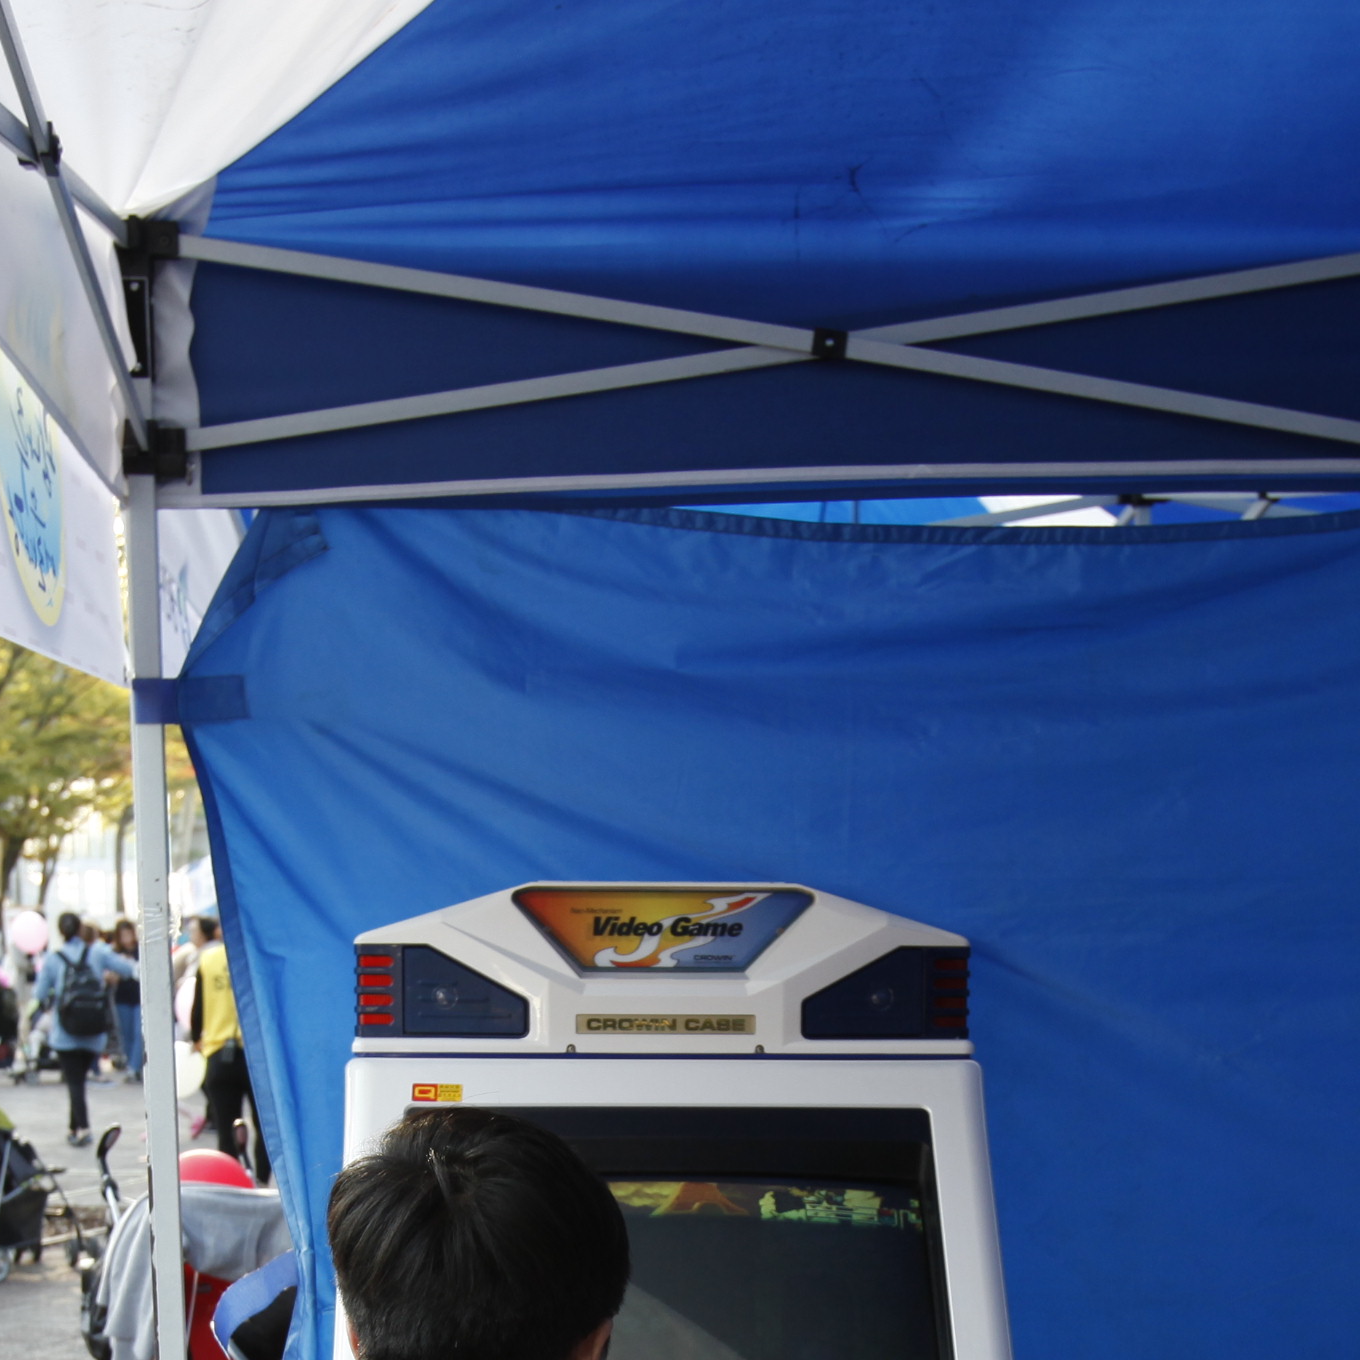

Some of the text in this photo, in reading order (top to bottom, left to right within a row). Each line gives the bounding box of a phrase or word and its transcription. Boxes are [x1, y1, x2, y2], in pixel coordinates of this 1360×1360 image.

[593, 916, 744, 938] Video Game
[694, 954, 734, 962] CROWIN
[586, 1018, 746, 1032] CROWIN CASE
